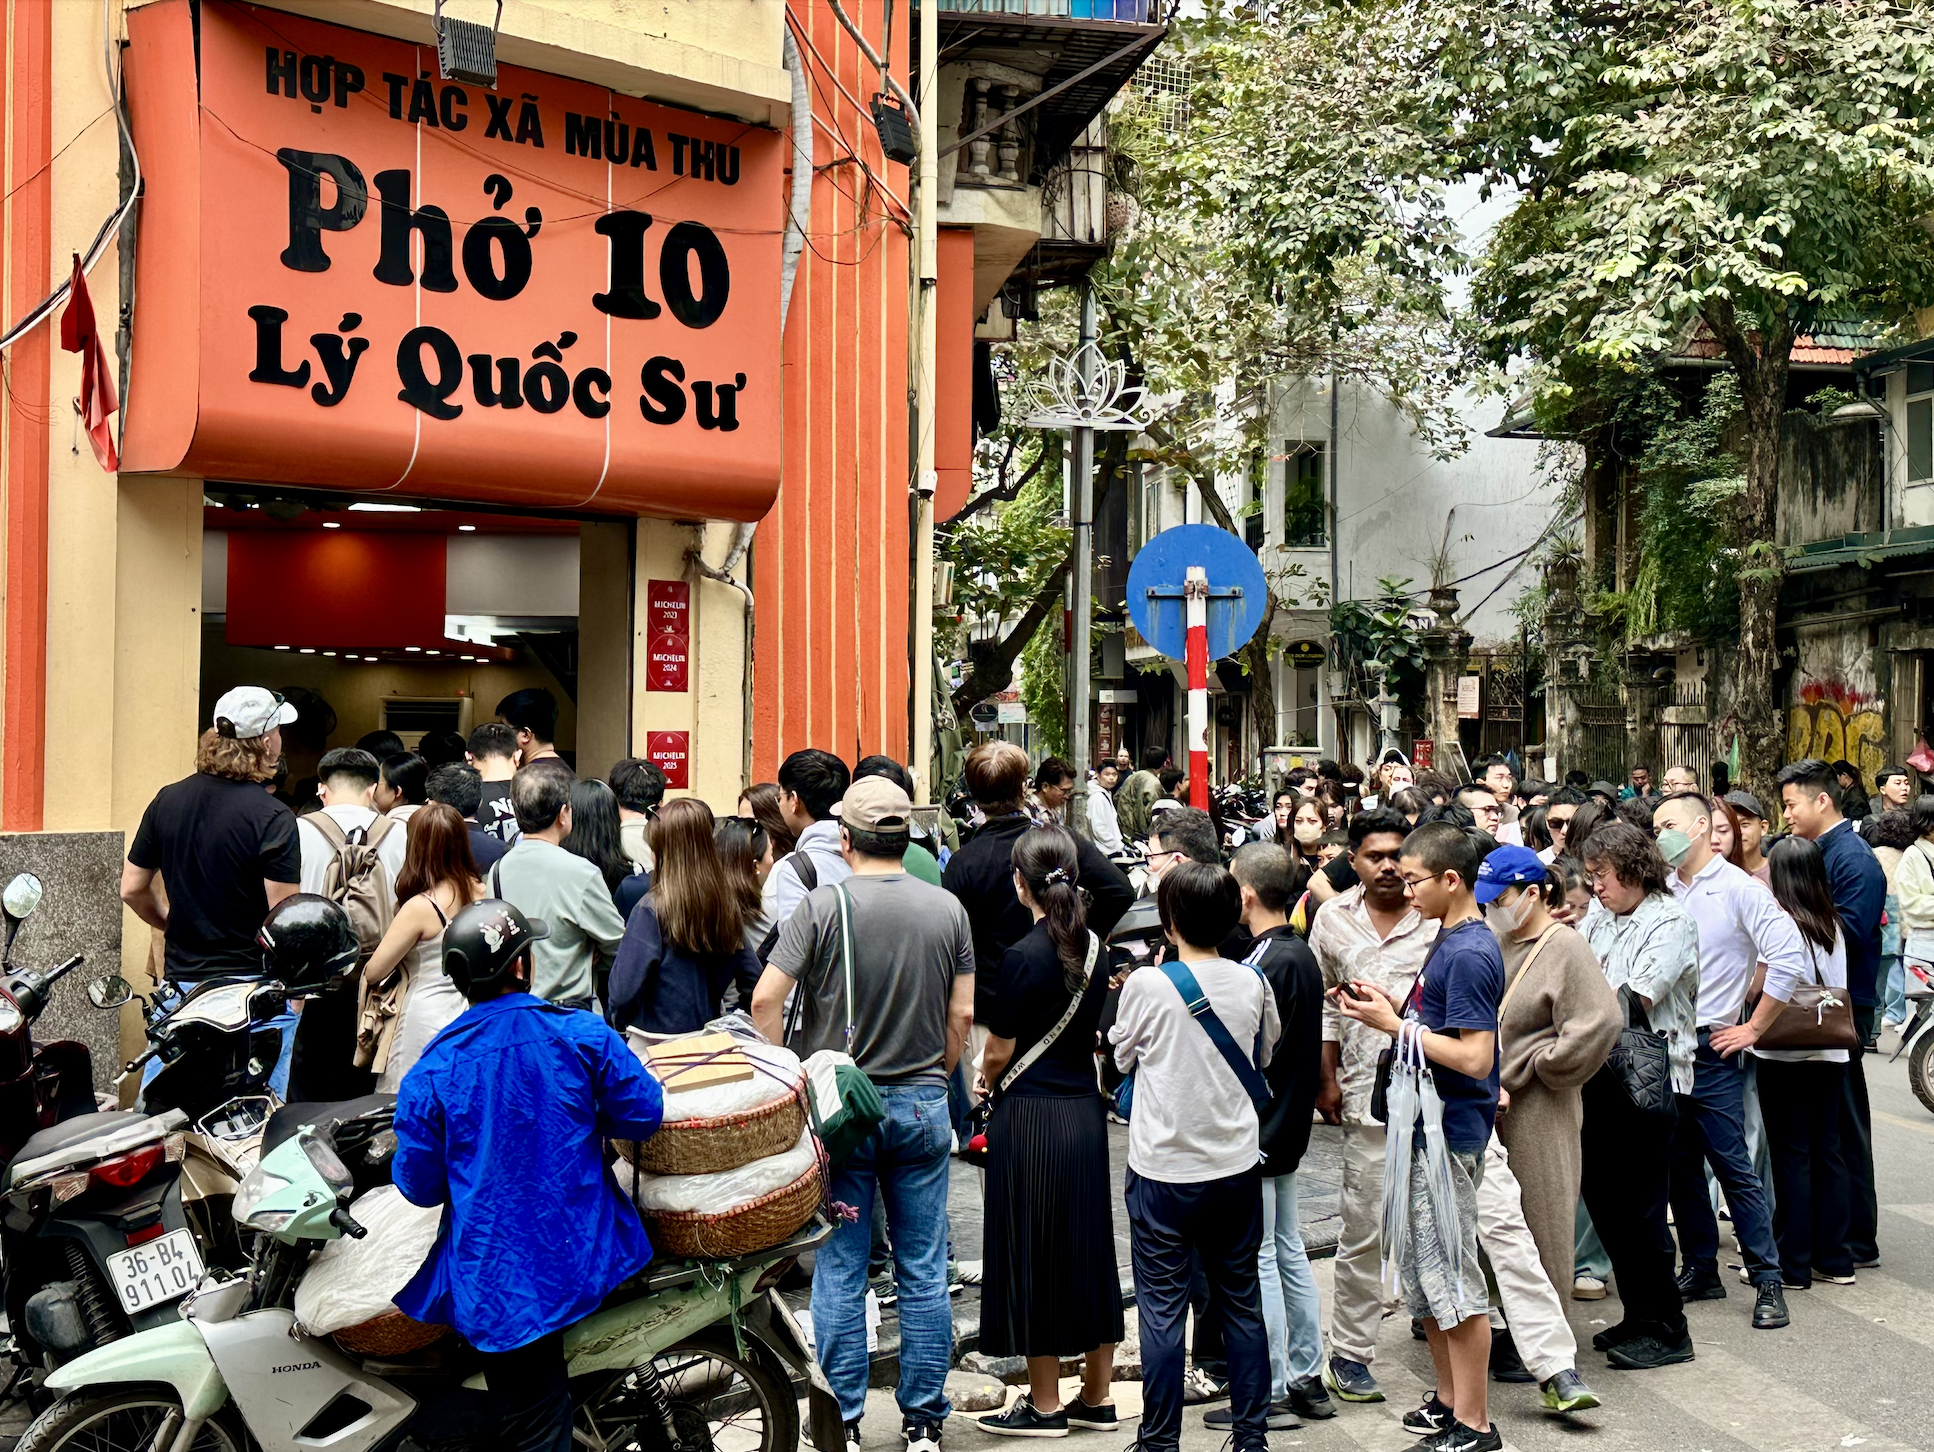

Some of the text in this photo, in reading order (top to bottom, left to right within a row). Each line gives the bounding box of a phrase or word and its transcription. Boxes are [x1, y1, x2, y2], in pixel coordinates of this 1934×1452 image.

[265, 46, 741, 186] HỢP TÁC XÃ MÙA THU
[276, 147, 730, 329] Phở 10
[247, 305, 747, 432] Lý Quốc Sư
[654, 600, 686, 610] MICHELIN
[653, 653, 685, 662] MICHELIN
[653, 752, 685, 760] MICHELIN
[121, 1238, 184, 1279] 36-B4
[125, 1260, 200, 1307] 911.04
[272, 1361, 322, 1374] HONDA
